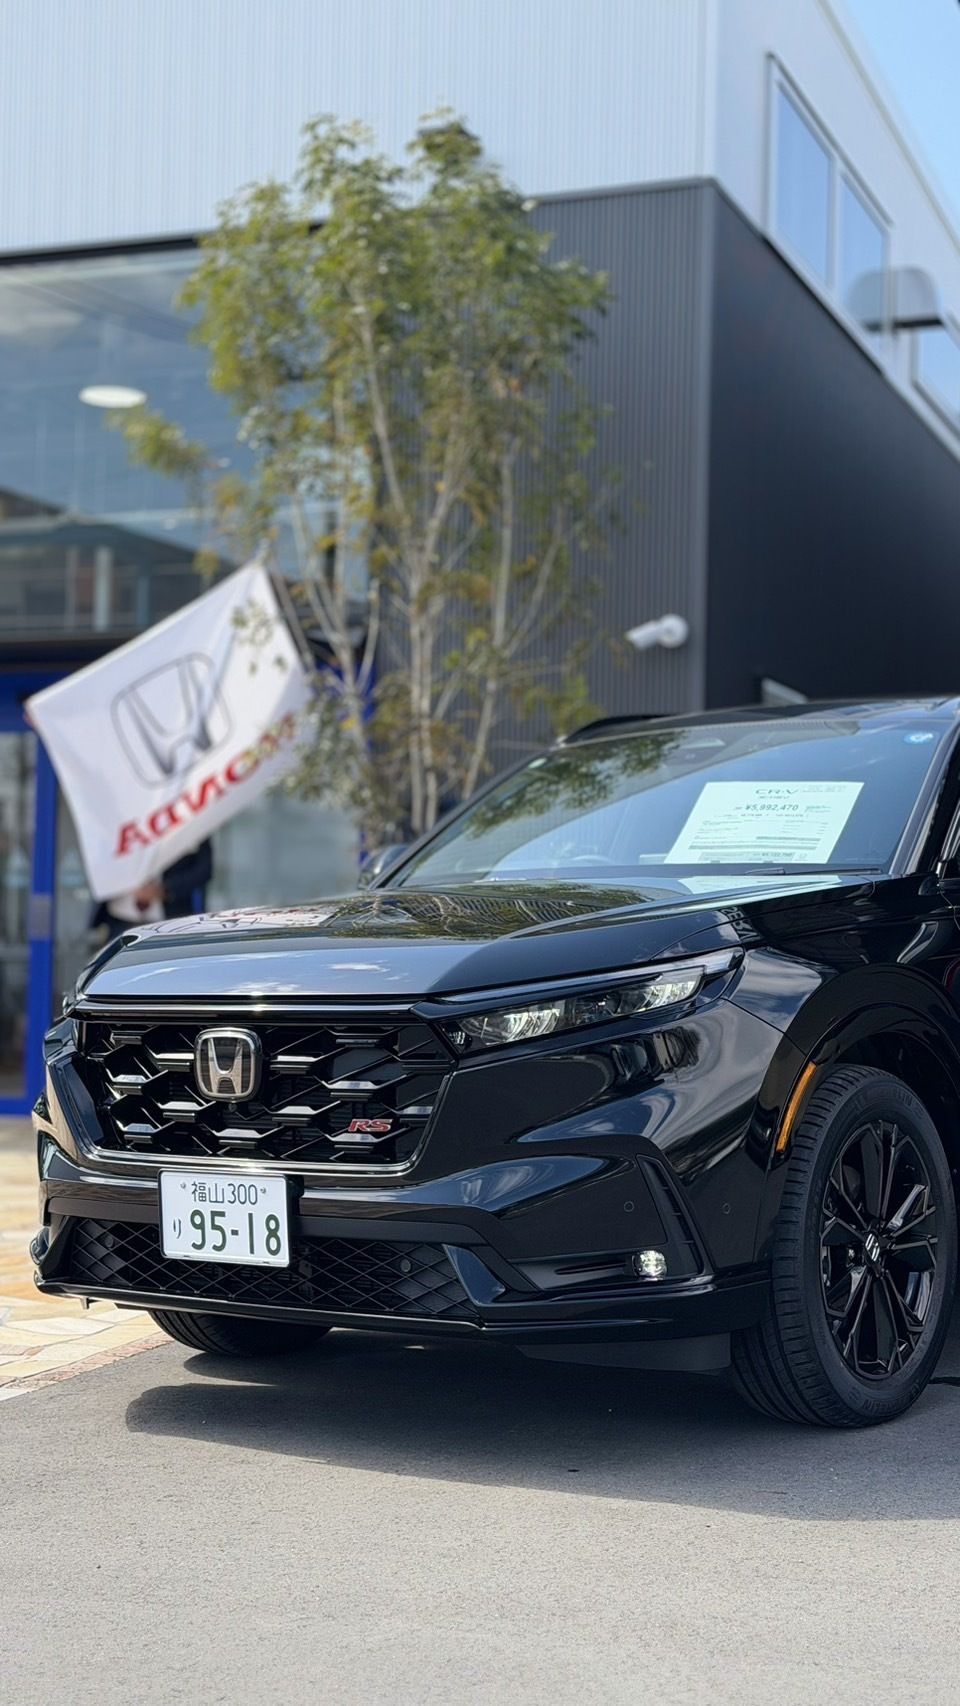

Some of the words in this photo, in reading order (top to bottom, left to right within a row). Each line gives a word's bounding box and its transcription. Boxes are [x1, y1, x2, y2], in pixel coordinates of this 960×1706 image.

[348, 1118, 393, 1132] RS
[191, 1181, 258, 1205] 福山300
[190, 1209, 281, 1256] 95-18
